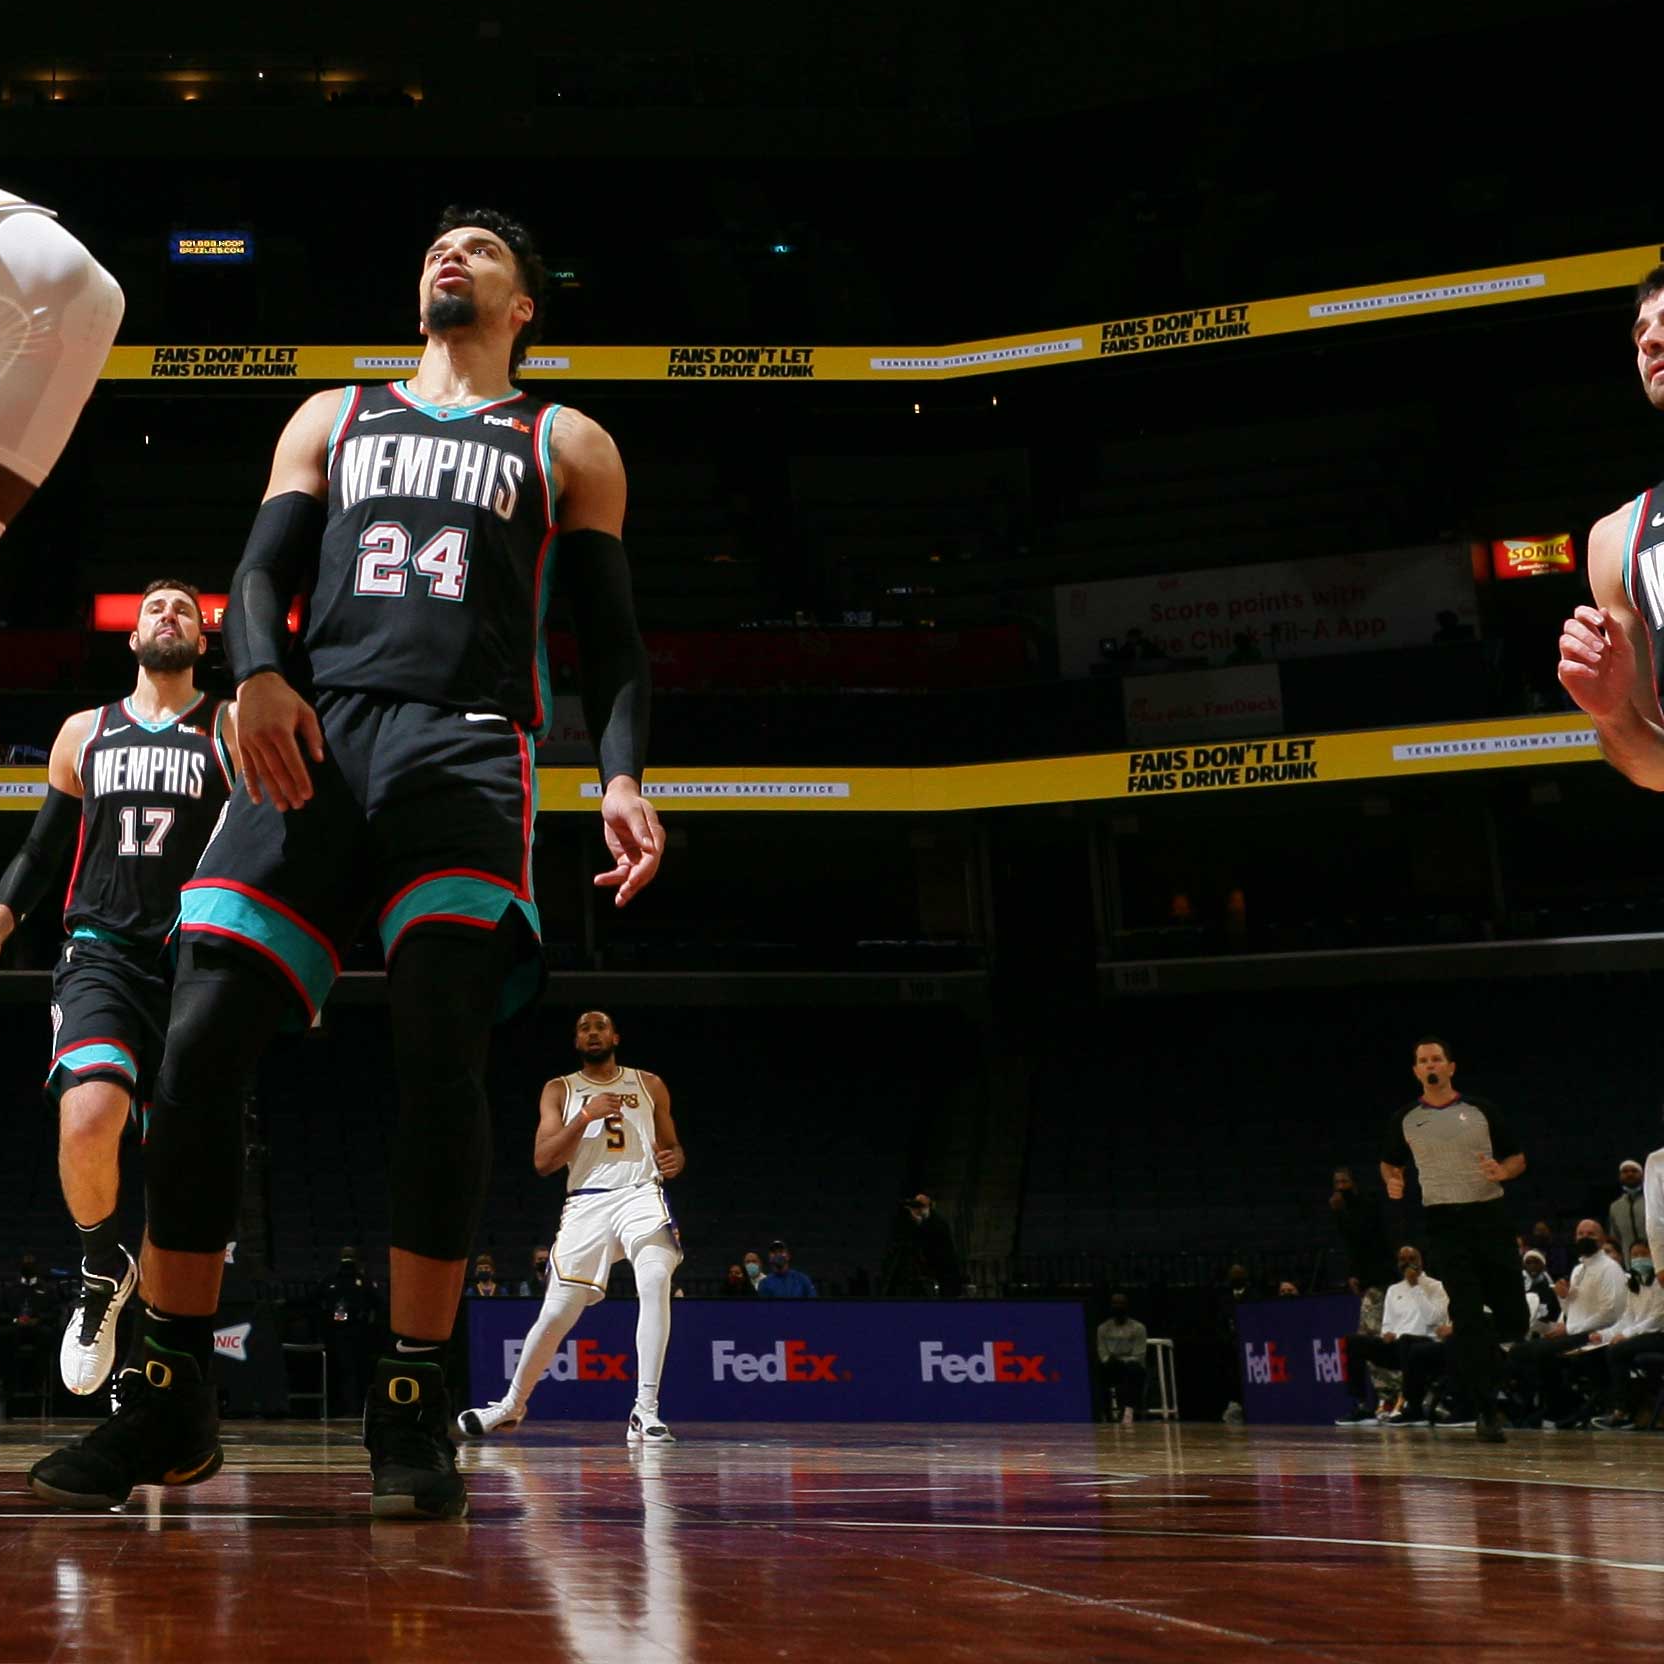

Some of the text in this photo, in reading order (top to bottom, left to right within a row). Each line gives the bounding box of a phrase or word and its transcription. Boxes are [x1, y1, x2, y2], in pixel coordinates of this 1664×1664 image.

[1320, 278, 1531, 313] TENNESSEE HIGHWAY SAFETY OFFICE
[1101, 305, 1249, 340] FANS DON'T LET
[943, 355, 987, 365] HIGHWAY
[992, 349, 1029, 359] SAFETY
[1034, 342, 1071, 353] OFFICE
[1100, 323, 1250, 354] FANS DRIVE DRUNK
[154, 346, 298, 363] FANS DON'T LET
[669, 347, 814, 363] FANS DON'T LET
[151, 364, 298, 377] FANS DRIVE DRUNK
[667, 365, 813, 377] FANS DRIVE DRUNK
[483, 415, 531, 434] FedEx
[341, 434, 527, 523] MEMPHIS
[354, 520, 469, 602] 24
[1512, 543, 1566, 561] SONIC
[1129, 740, 1316, 774] FANS DON'T LET
[1406, 736, 1557, 755] TENNESSEE HIGHWAY
[94, 745, 206, 799] MEMPHIS
[1128, 762, 1317, 792] FANS DRIVE DRUNK
[672, 785, 729, 793] HIGHWAY
[736, 785, 782, 793] SAFETY
[789, 785, 835, 793] OFFICE
[118, 806, 175, 856] 17
[604, 1115, 625, 1152] 5
[712, 1340, 838, 1384] FedEx
[920, 1341, 1047, 1384] FedEx
